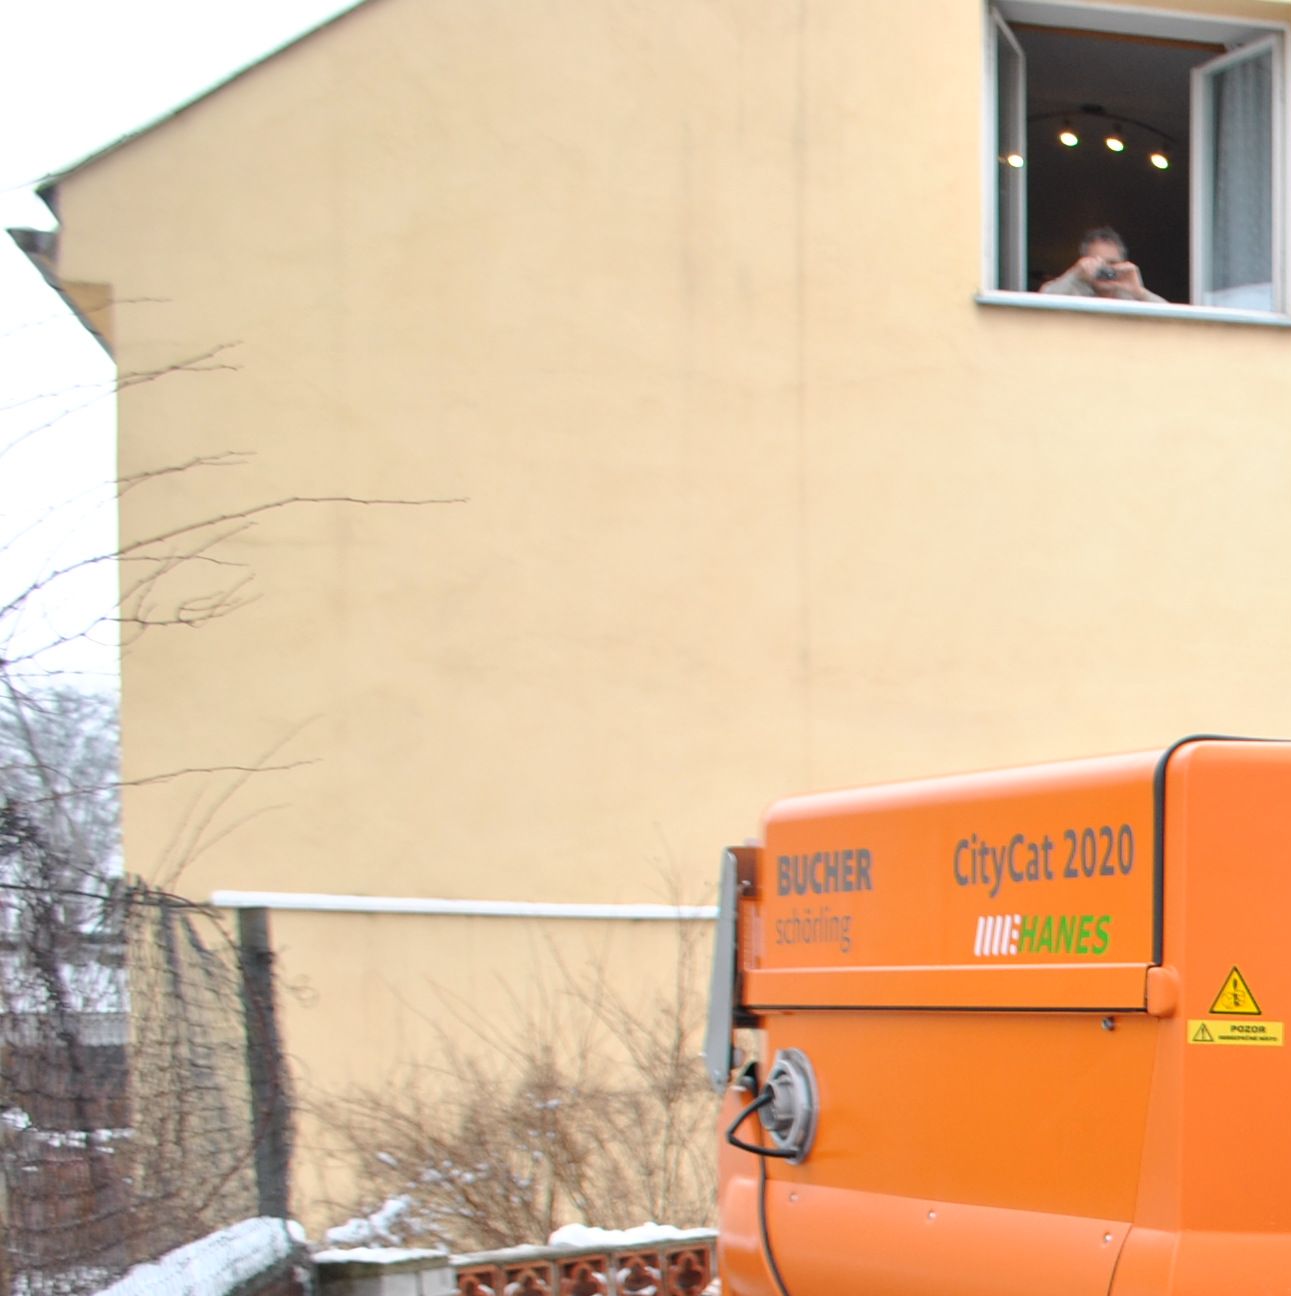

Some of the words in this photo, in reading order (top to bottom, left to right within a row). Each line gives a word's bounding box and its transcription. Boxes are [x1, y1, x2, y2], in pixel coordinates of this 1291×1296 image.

[776, 848, 873, 896] BUCHER
[953, 832, 1054, 899] CityCat
[1063, 823, 1135, 879] 2020
[775, 905, 852, 954] schörling
[1018, 914, 1113, 955] HANES
[1230, 1024, 1267, 1034] POZOR
